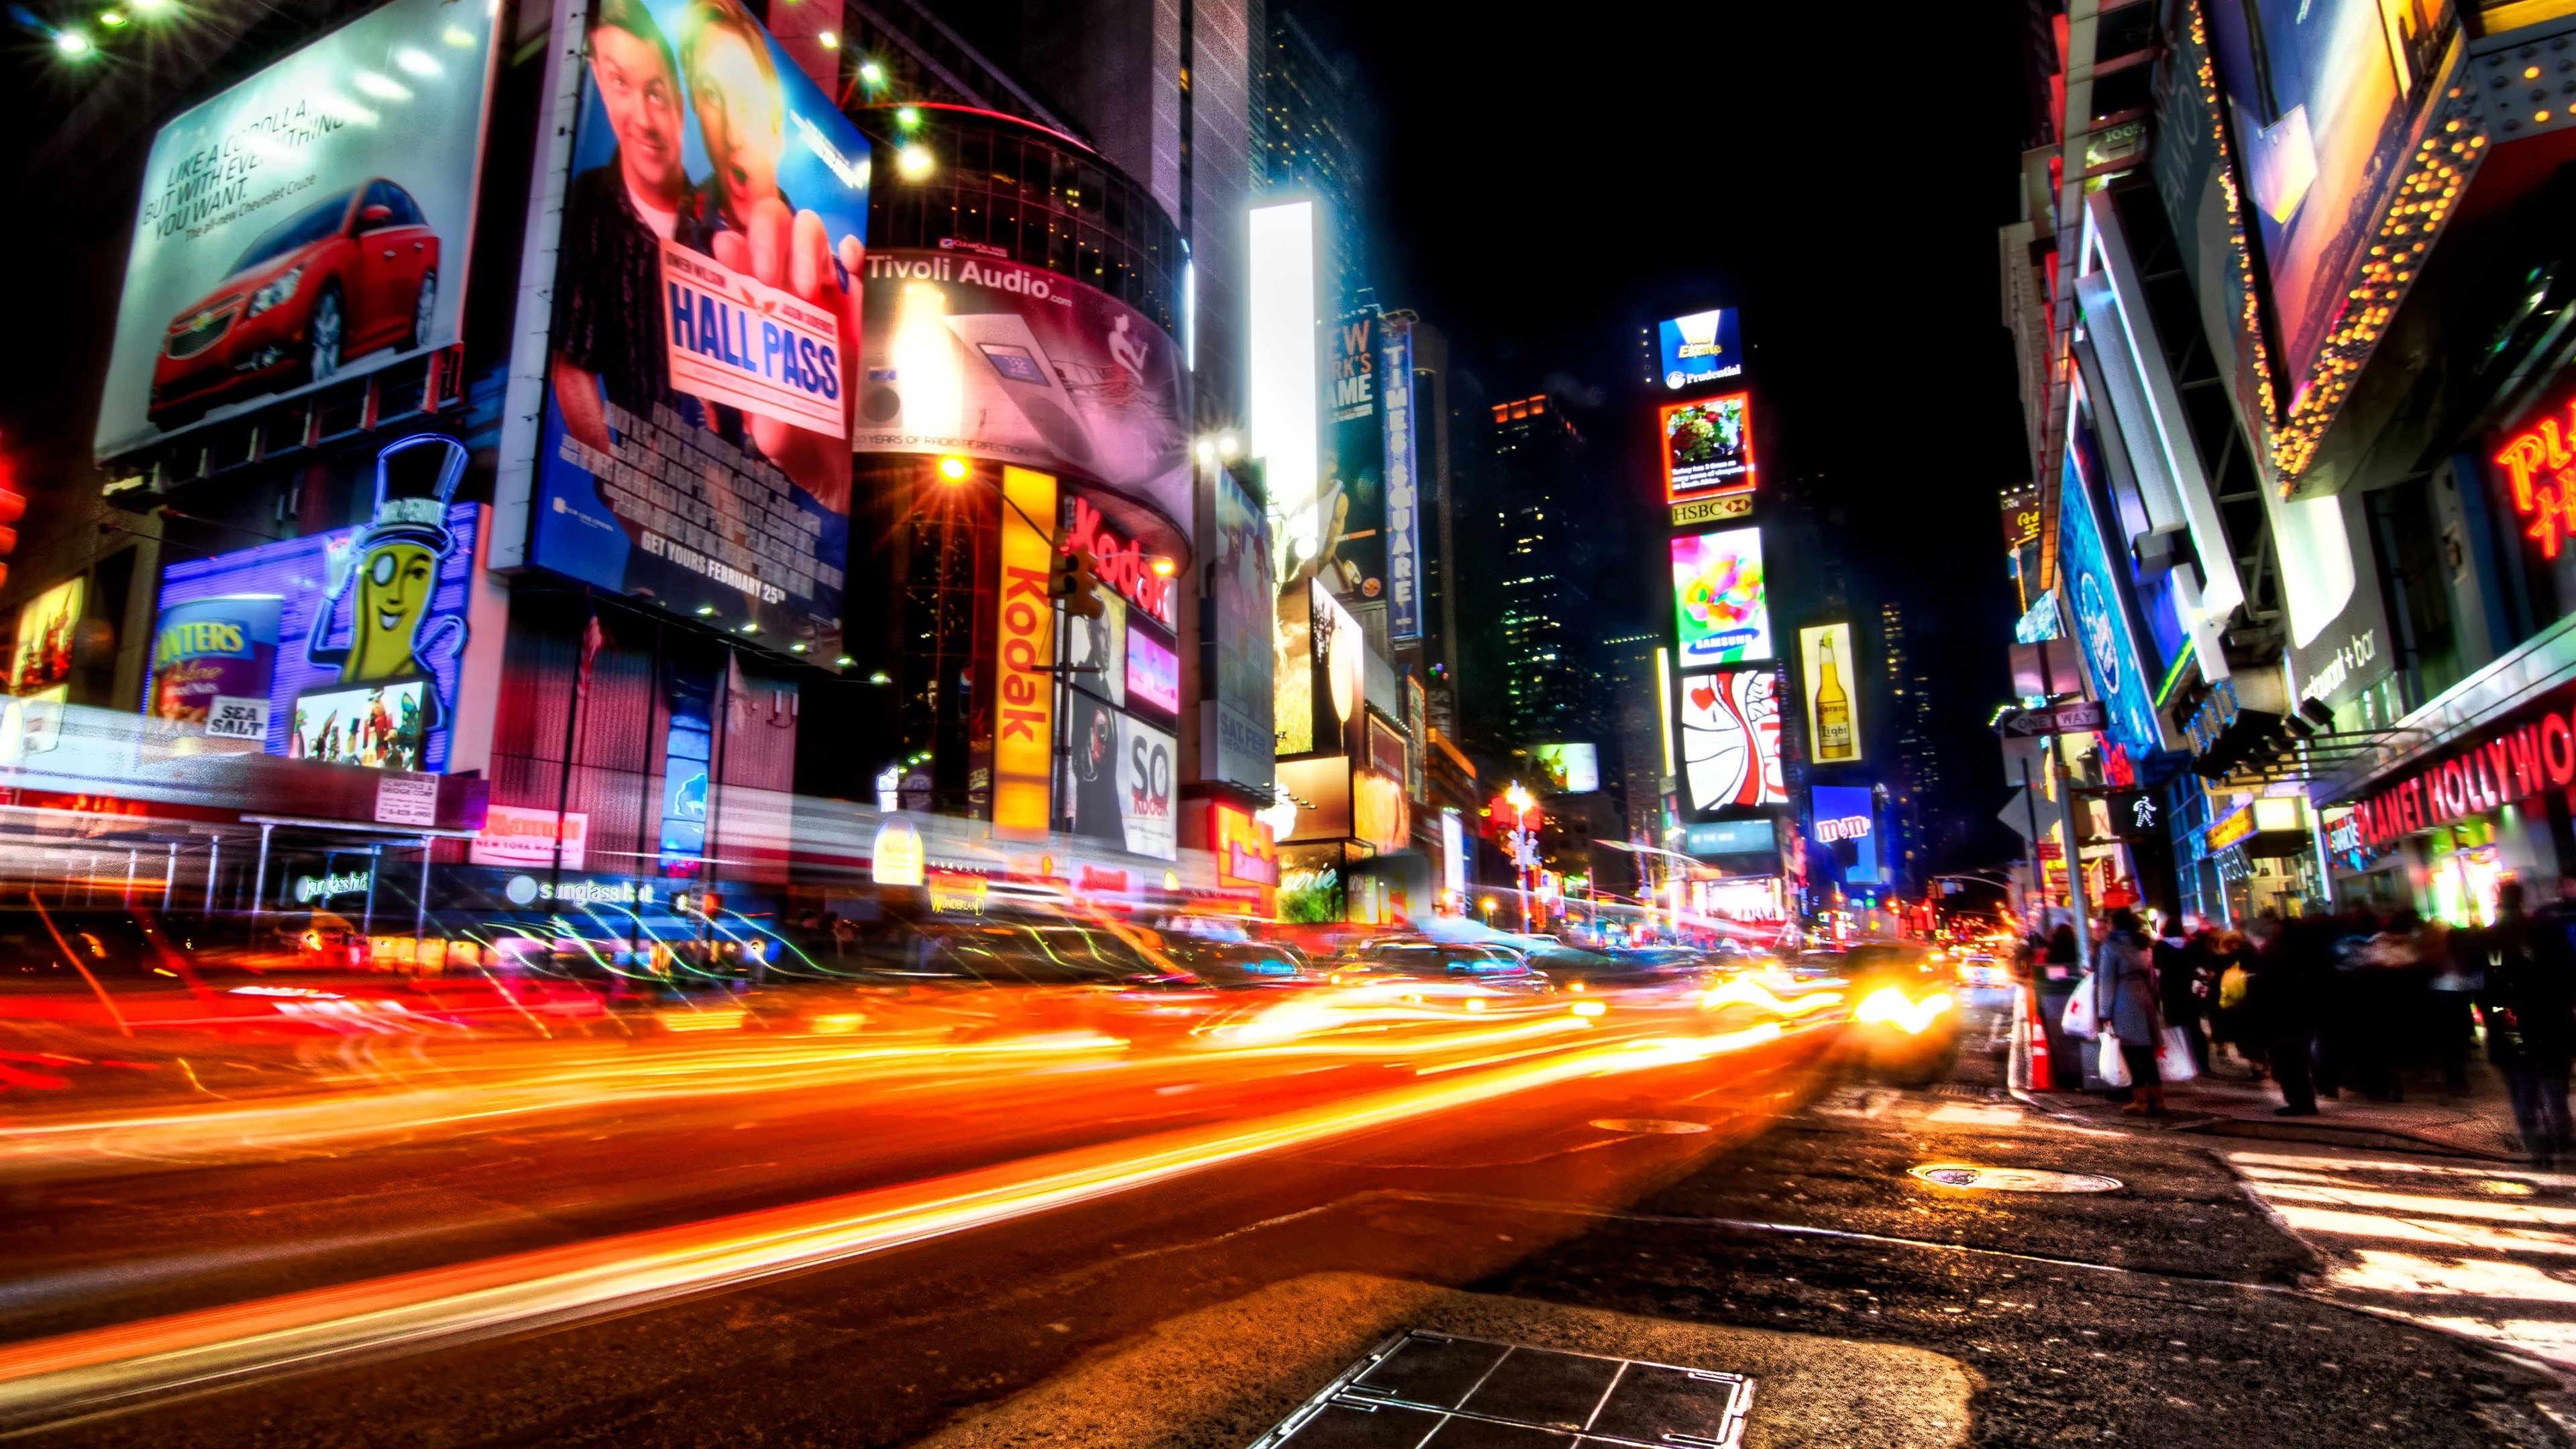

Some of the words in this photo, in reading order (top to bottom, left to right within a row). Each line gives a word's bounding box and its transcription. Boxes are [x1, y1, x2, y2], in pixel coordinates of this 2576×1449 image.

[168, 151, 204, 188] LIKE
[207, 144, 218, 163] A
[143, 189, 175, 225] BUT
[178, 166, 223, 205] WITH
[239, 188, 284, 217] Chevrolet
[287, 174, 316, 196] Cruze
[156, 203, 190, 241] YOU
[865, 254, 951, 282] Tivoli
[958, 260, 1050, 299] Audio
[668, 280, 757, 374] HALL
[762, 321, 838, 400] PASS
[1686, 364, 1741, 384] Prudential
[869, 434, 903, 445] YEARS
[907, 435, 920, 445] OF
[924, 436, 961, 448] RADIO
[962, 439, 1030, 457] PERFECTION
[1674, 502, 1722, 521] HSBC
[641, 531, 667, 557] GET
[667, 540, 707, 575] YOURS
[706, 559, 762, 598] FEBRUARY
[1070, 495, 1172, 624] Kodak
[1002, 565, 1051, 743] Kodak
[2351, 628, 2376, 668] bar
[210, 718, 264, 737] SALT
[221, 704, 258, 722] SEA
[1821, 724, 1847, 738] Light
[2017, 715, 2047, 729] ONE
[2060, 711, 2092, 724] WAY
[1130, 735, 1171, 800] SO
[2353, 777, 2426, 851] PLANET
[2423, 712, 2576, 826] HOLLYWO
[476, 840, 498, 848] NEW
[504, 841, 530, 850] YORK
[534, 844, 581, 854] MARUIS
